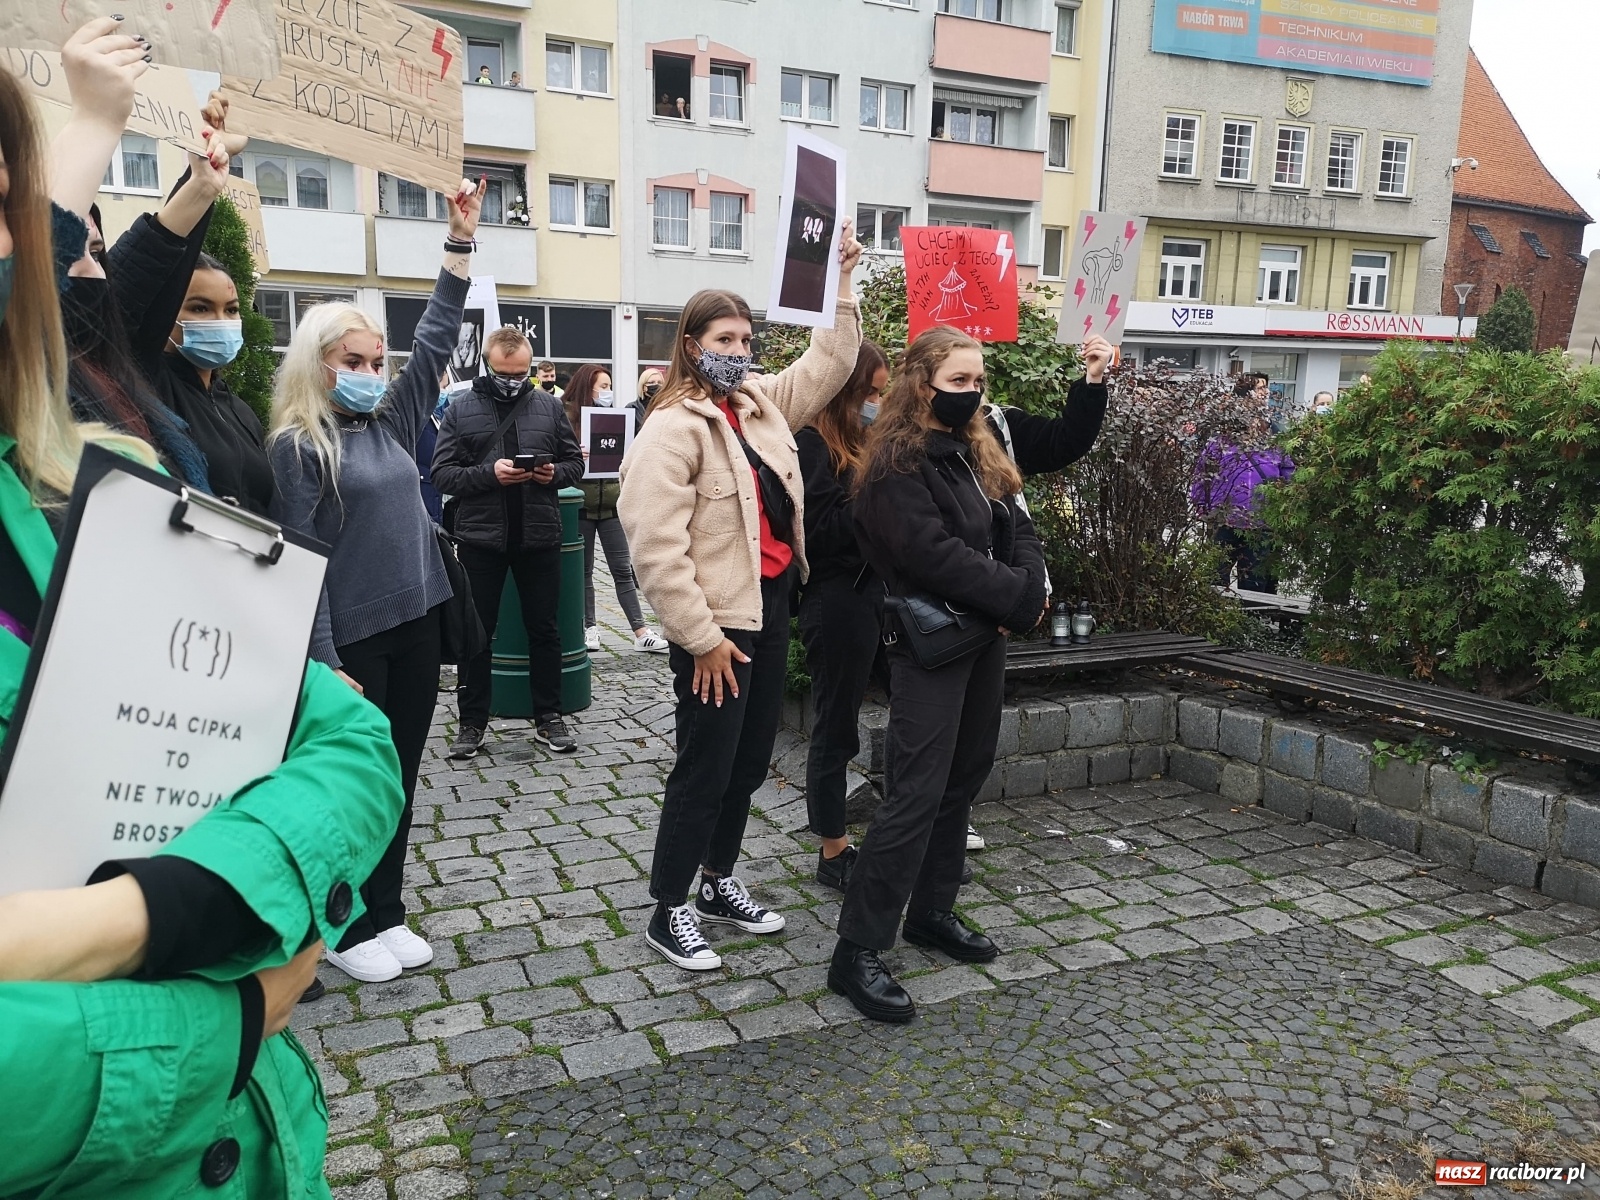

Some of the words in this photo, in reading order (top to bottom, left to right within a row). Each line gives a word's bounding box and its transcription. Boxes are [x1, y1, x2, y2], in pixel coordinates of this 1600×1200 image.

[1182, 10, 1214, 26] NABÓR
[1218, 15, 1244, 29] TRWA
[394, 20, 417, 53] Z
[1278, 21, 1363, 43] TECHNIKUM
[276, 18, 389, 91] IRUSEM,
[398, 58, 439, 102] NIE
[1276, 45, 1352, 64] AKADEMIA
[1355, 55, 1364, 66] III
[1367, 57, 1413, 72] WIEKU
[130, 91, 195, 140] ENIA
[293, 74, 450, 160] KOBIETAMI
[917, 231, 974, 251] CHCEMY
[957, 251, 966, 266] Z
[970, 251, 998, 266] TEGO
[1191, 308, 1214, 319] TEB
[1326, 313, 1424, 333] ROSSMANN
[117, 703, 178, 730] MOJA
[187, 716, 242, 741] CIPKA
[166, 750, 190, 769] TO
[106, 782, 146, 803] NIE
[113, 822, 185, 844] BROSZ
